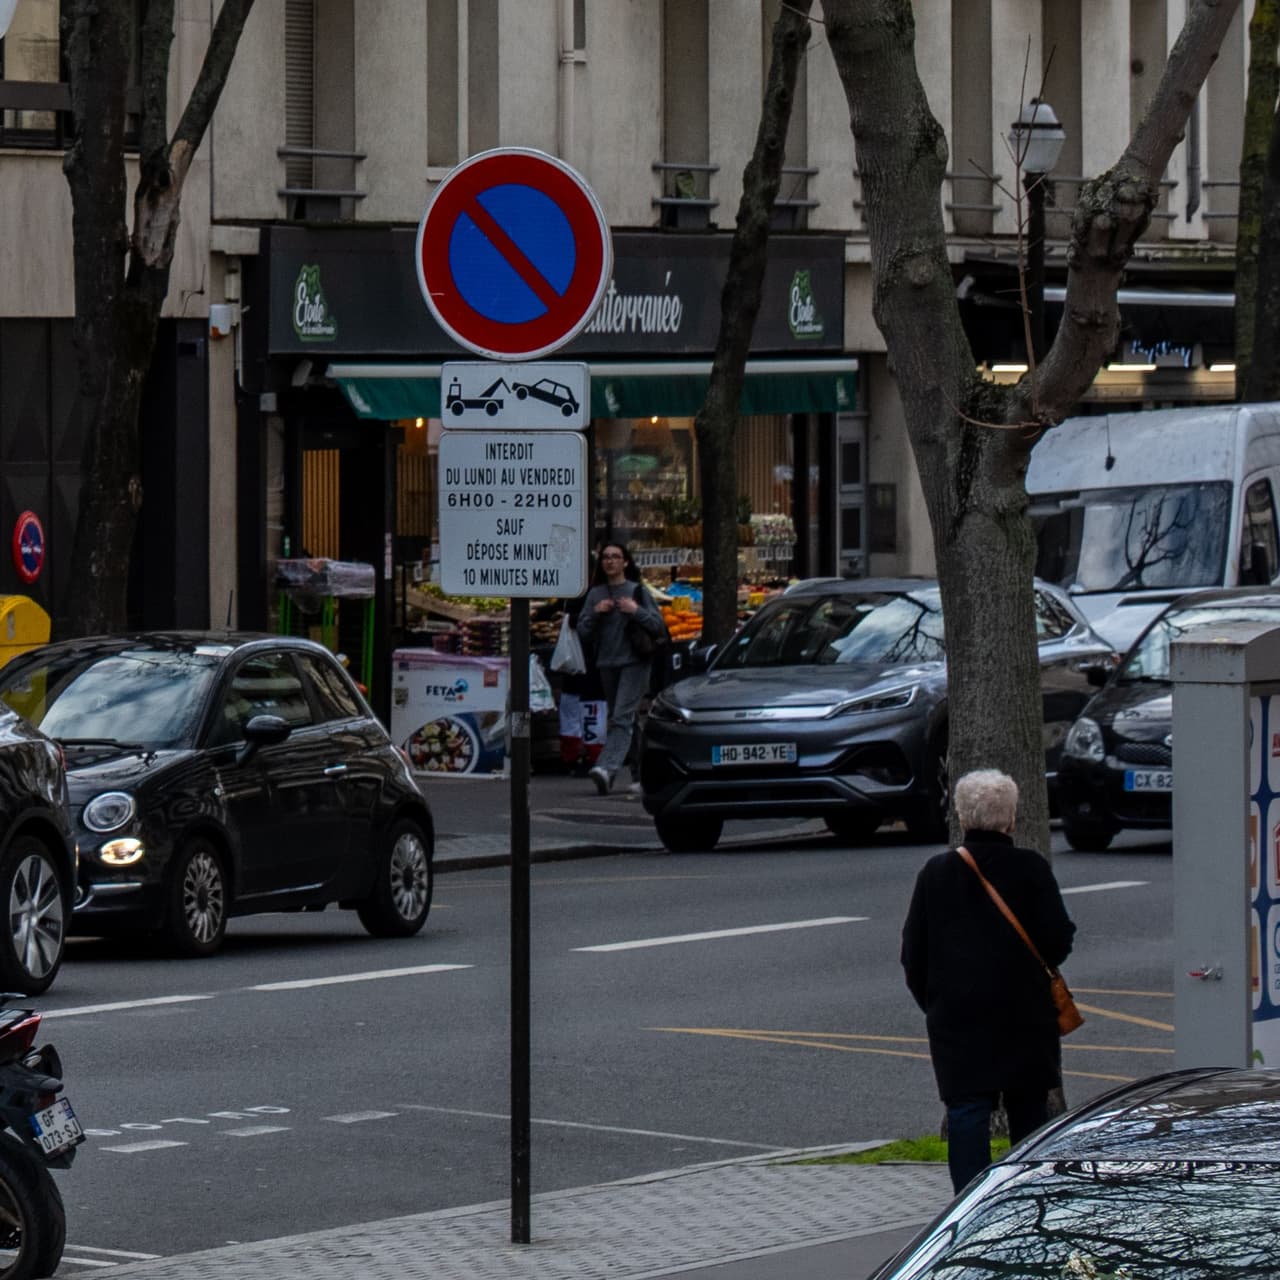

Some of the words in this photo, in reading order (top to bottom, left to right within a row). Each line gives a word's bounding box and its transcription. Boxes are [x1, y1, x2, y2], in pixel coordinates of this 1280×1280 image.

[485, 443, 534, 460] INTERDIT
[446, 468, 460, 485] DU
[464, 468, 496, 485] LUNDI
[501, 468, 515, 485] AU
[520, 468, 575, 485] VENDREDI
[448, 493, 494, 507] 6H00
[514, 493, 572, 508] 22H00
[496, 519, 525, 535] SAUF
[467, 539, 509, 561] DÉPOSE
[514, 544, 548, 561] MINUT
[464, 569, 476, 585] 10
[480, 569, 528, 585] MINUTES
[532, 569, 559, 586] MAXI
[426, 685, 456, 697] FETA
[583, 704, 597, 741] FILA
